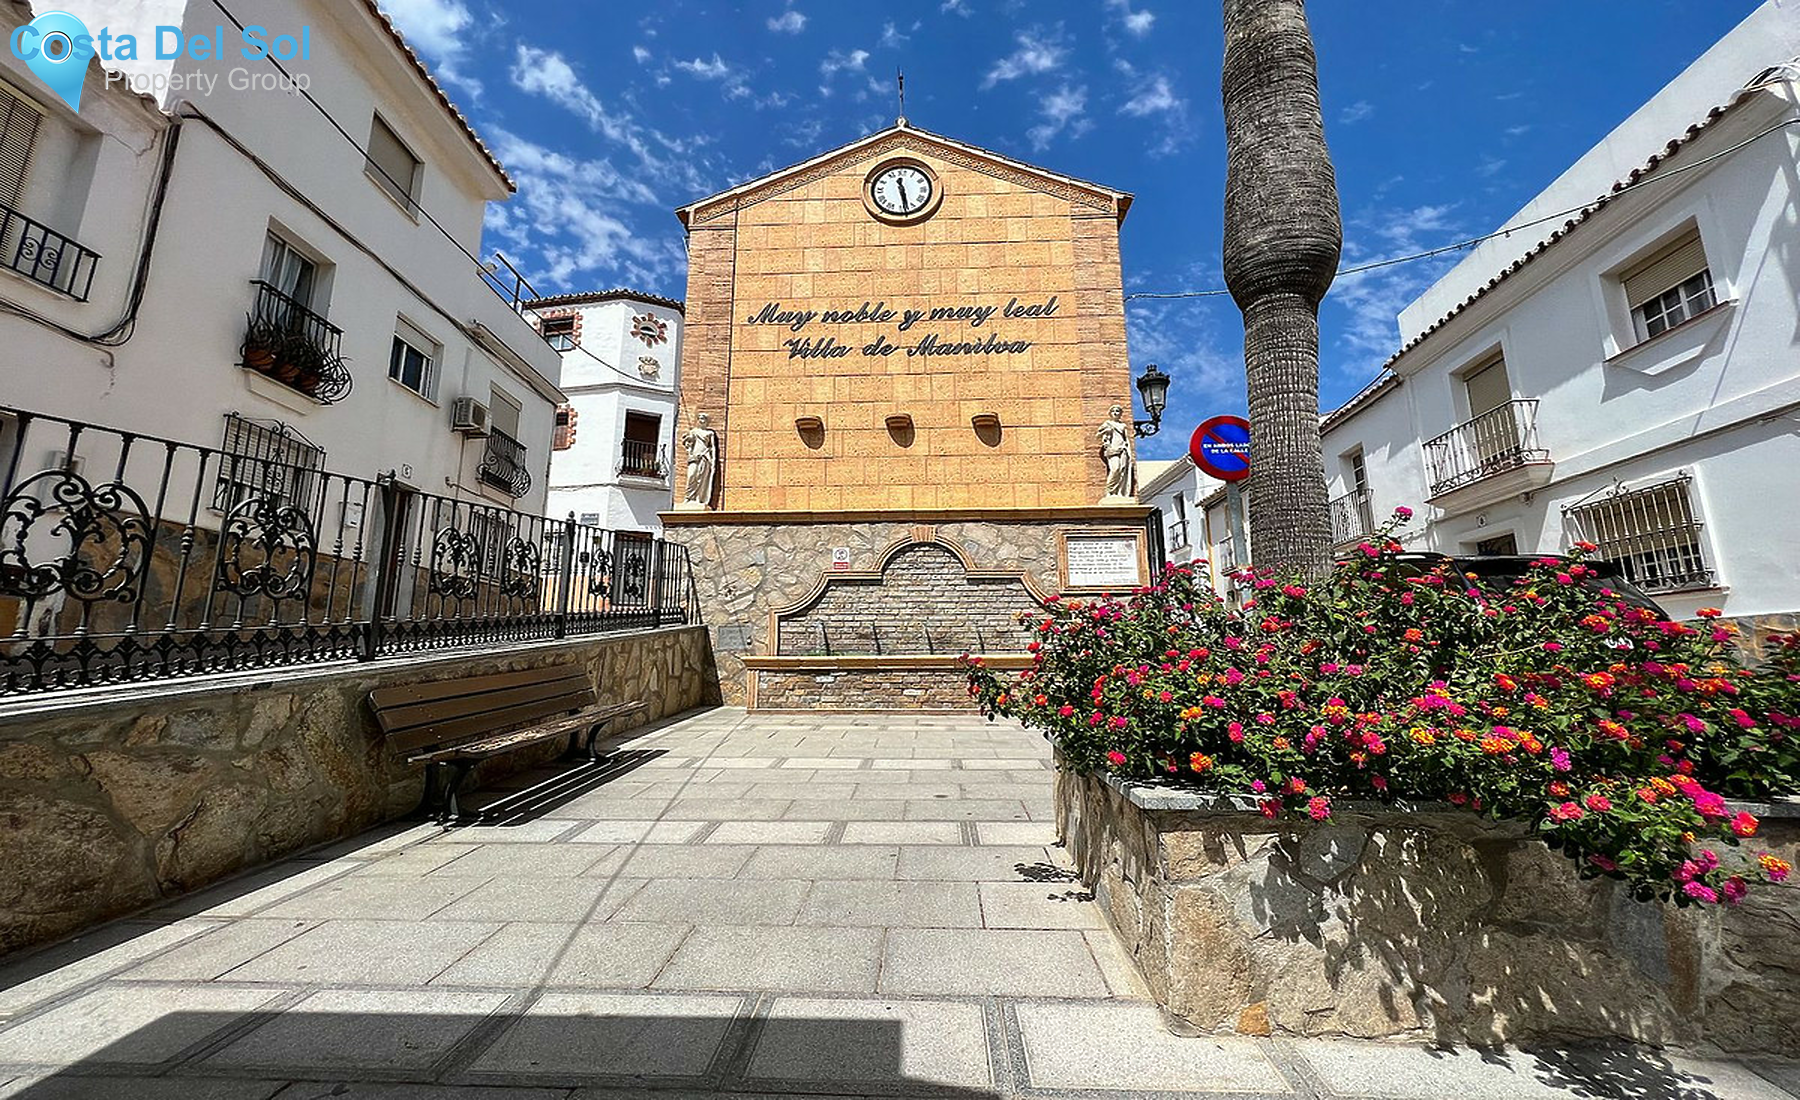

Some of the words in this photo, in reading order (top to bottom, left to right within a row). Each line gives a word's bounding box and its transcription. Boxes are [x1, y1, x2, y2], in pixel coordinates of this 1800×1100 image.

[747, 302, 817, 331] Muy
[821, 301, 897, 323] noble
[898, 308, 926, 331] y
[929, 305, 998, 326] muy
[1002, 296, 1060, 318] leal
[783, 336, 851, 360] Villa
[862, 335, 900, 357] de
[907, 333, 1033, 357] Manilva
